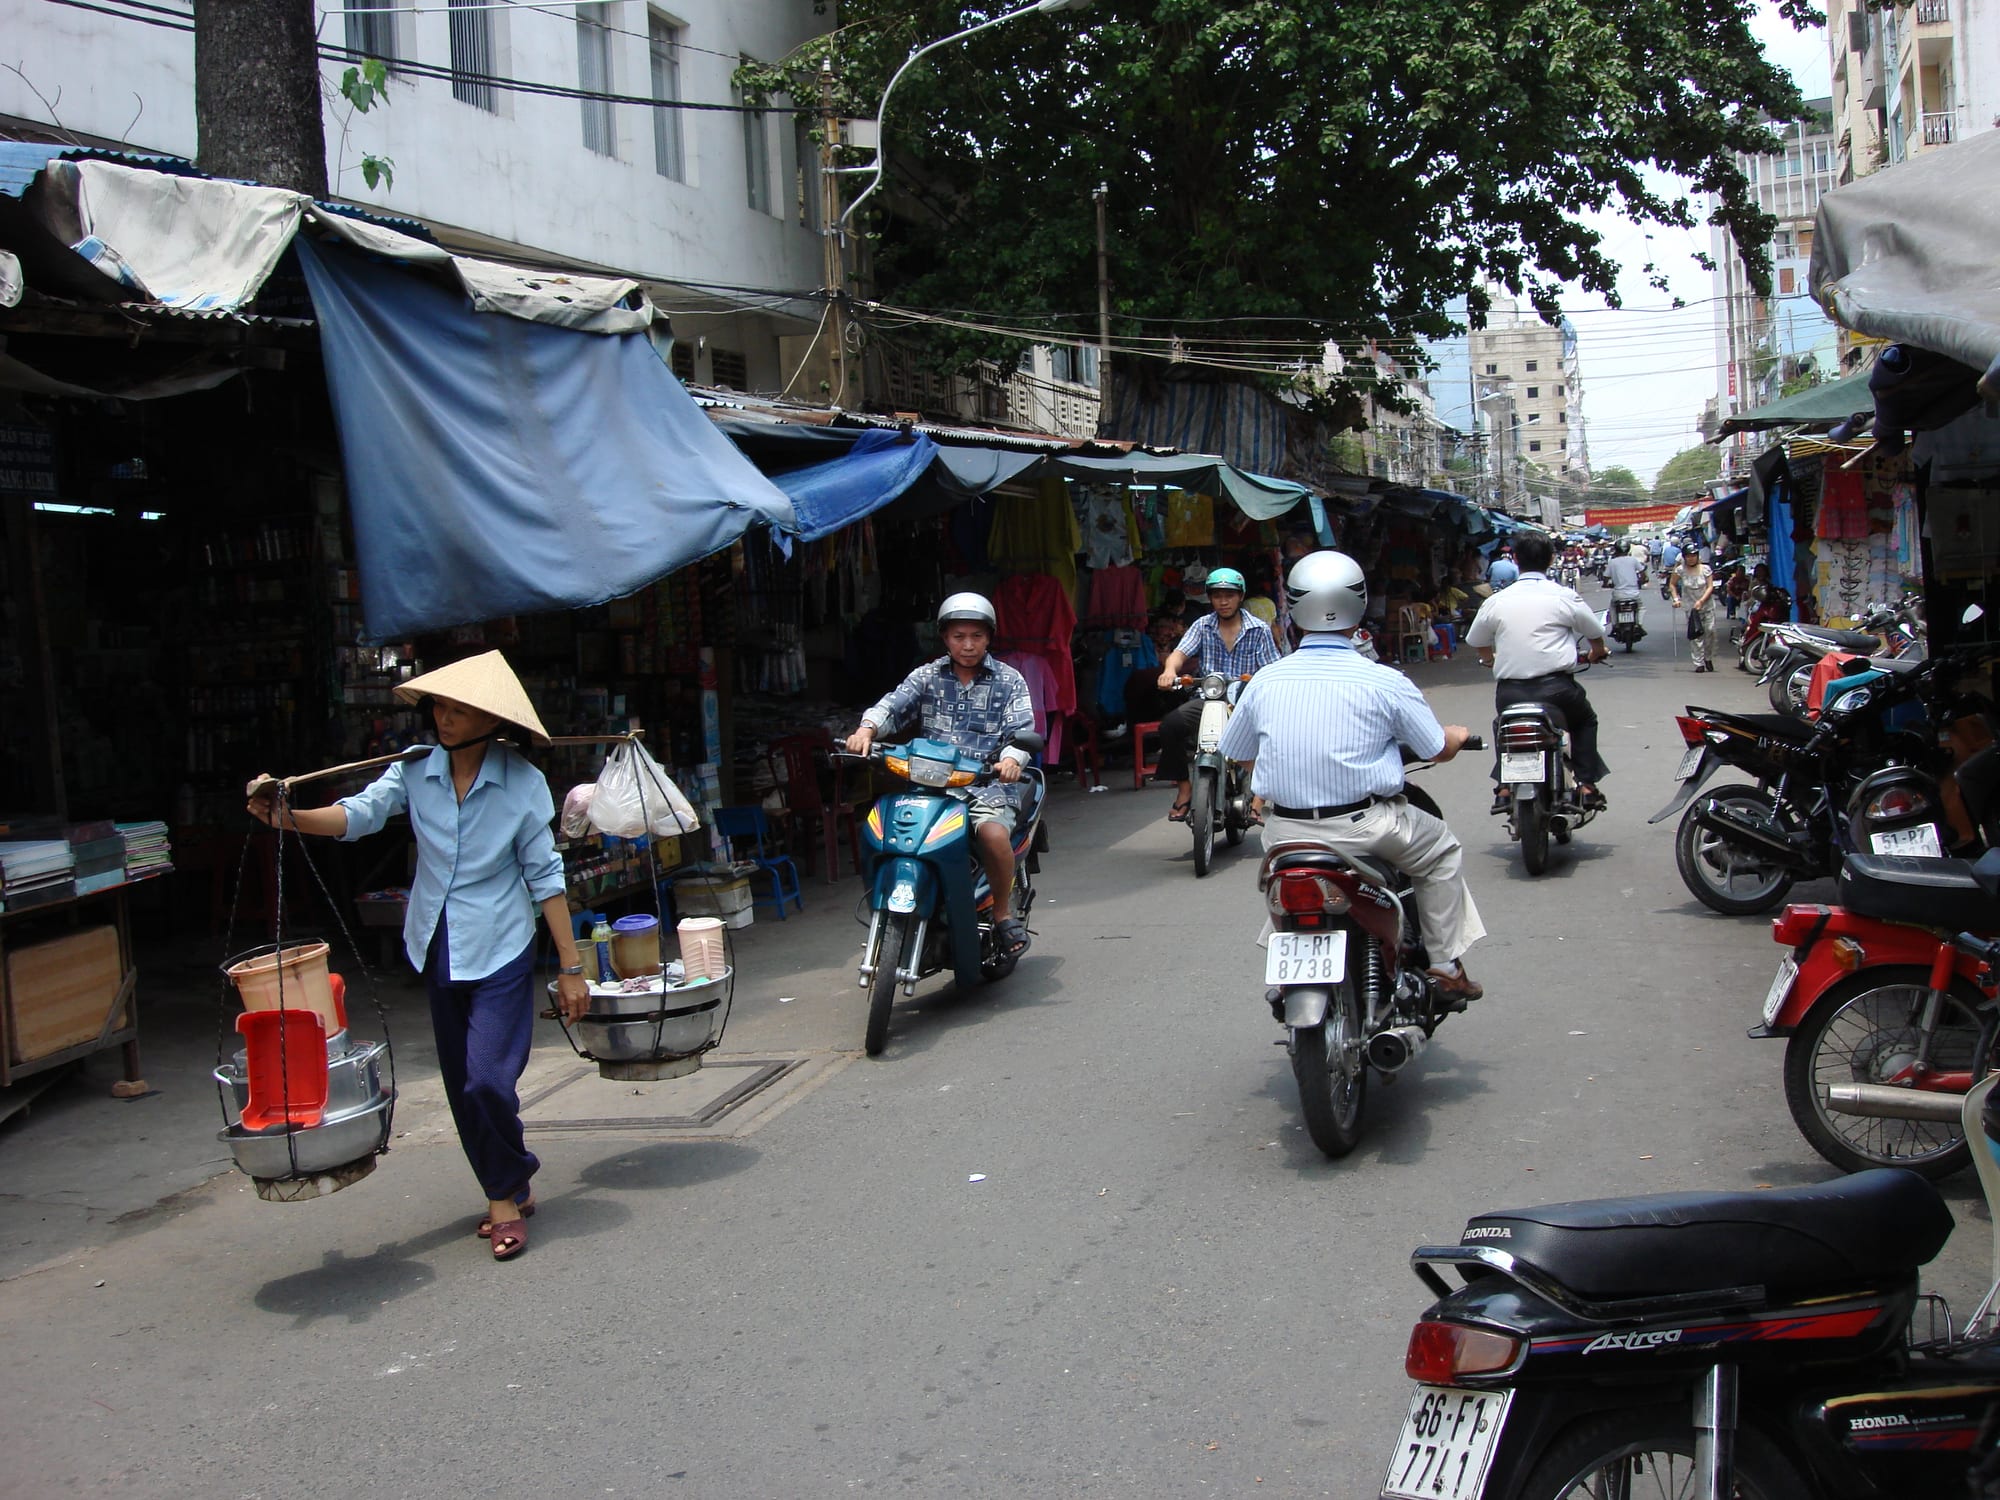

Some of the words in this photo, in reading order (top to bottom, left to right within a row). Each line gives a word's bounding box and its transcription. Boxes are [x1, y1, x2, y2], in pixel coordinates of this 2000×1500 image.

[1280, 935, 1331, 957] 51-R1
[1278, 958, 1332, 980] 8738
[1463, 1227, 1513, 1241] HONDA
[1581, 1328, 1684, 1356] Astrea
[1415, 1392, 1488, 1446] 66-F1
[1849, 1414, 1910, 1430] HONDA
